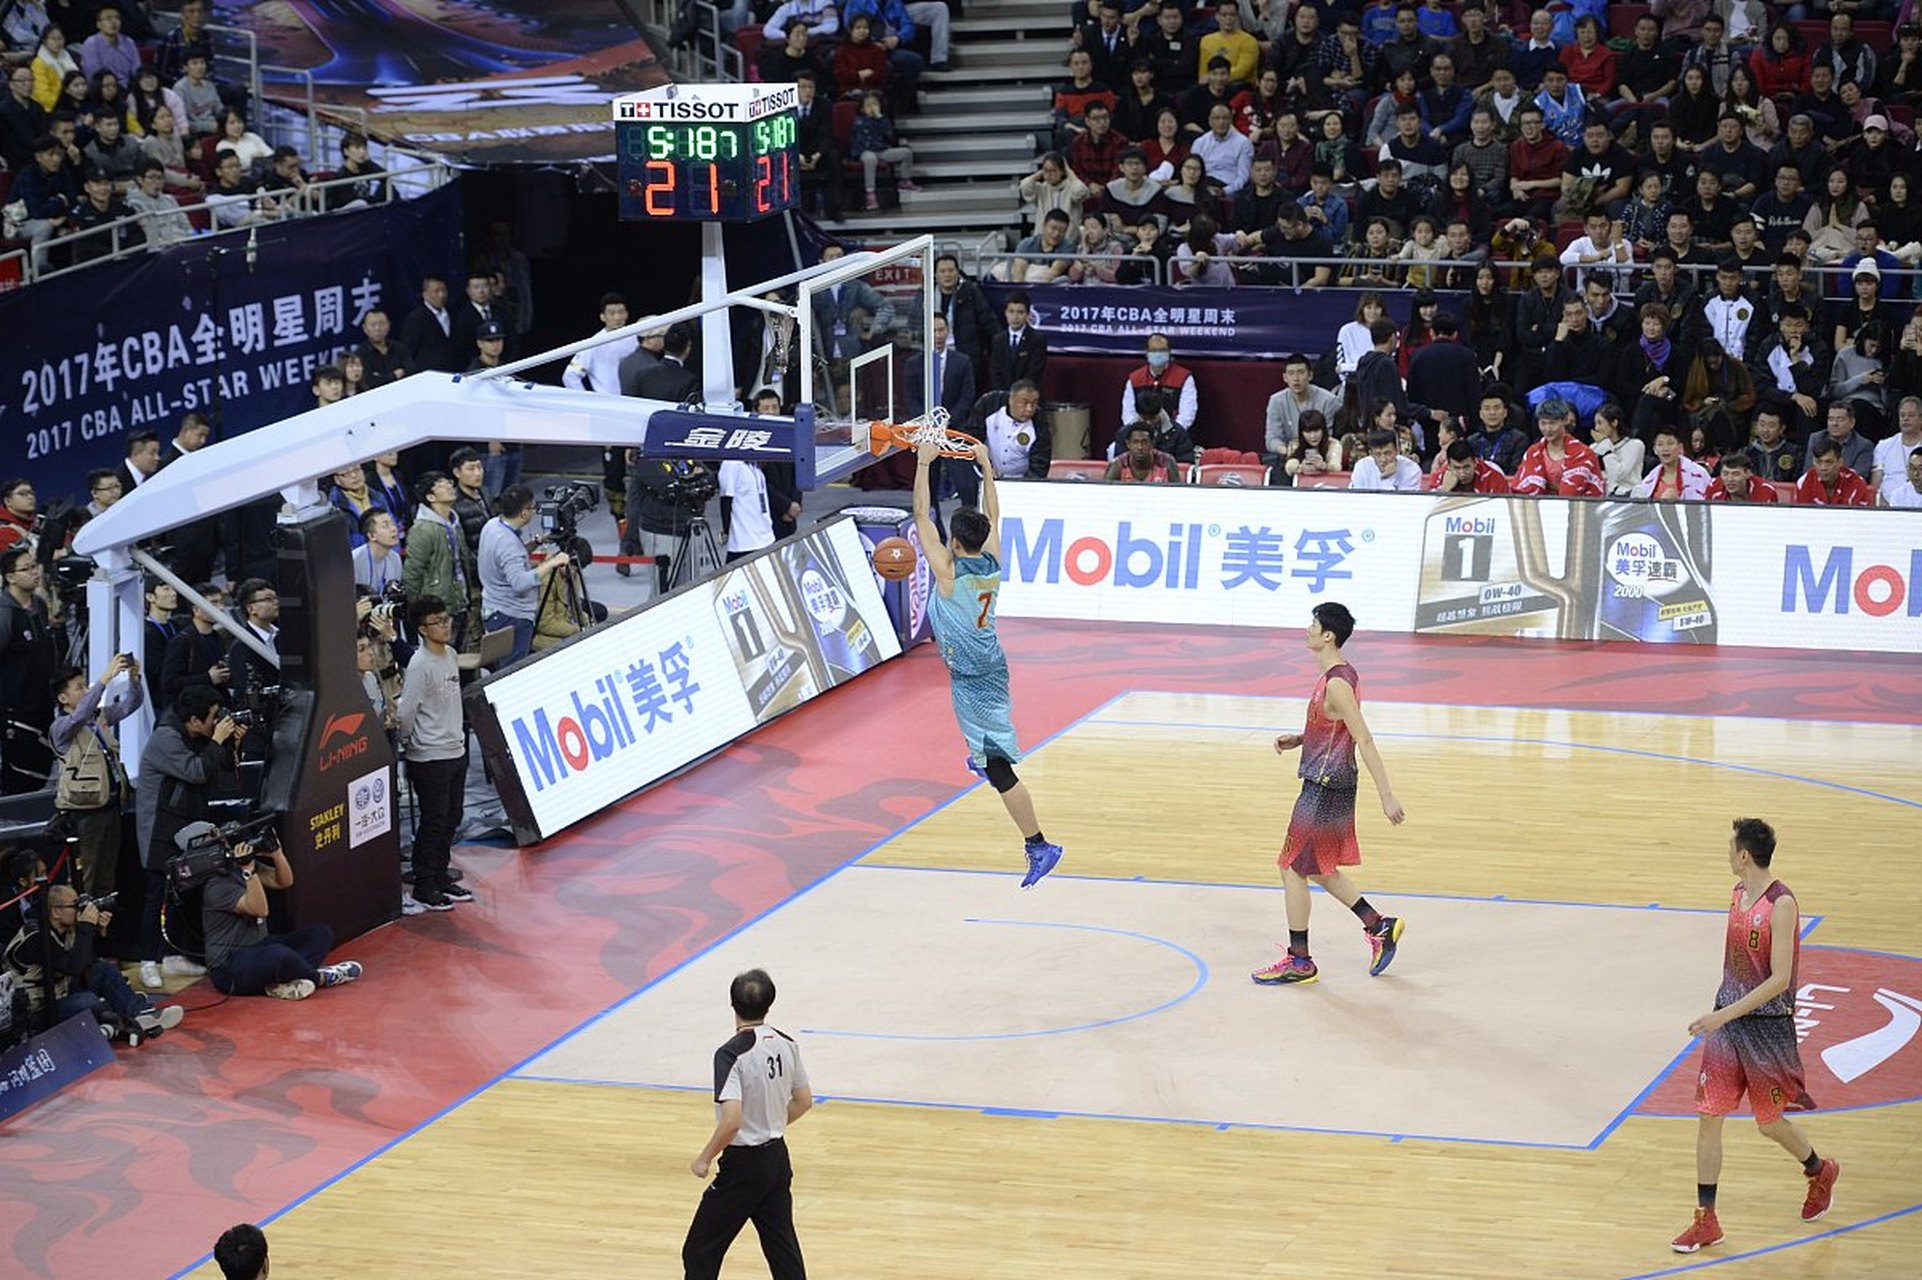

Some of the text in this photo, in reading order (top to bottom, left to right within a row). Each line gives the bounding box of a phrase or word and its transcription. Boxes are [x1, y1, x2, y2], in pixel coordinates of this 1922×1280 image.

[654, 102, 739, 119] TISSOT
[761, 88, 796, 112] TISSOT
[875, 268, 910, 281] EXIT
[1060, 305, 1236, 325] 2017年CBA全明星周末
[1060, 323, 1236, 337] 2017 CBA ALL-STAR WEEKEND
[26, 420, 72, 460] 2017
[81, 404, 123, 441] CBA
[131, 372, 250, 427] ALL-STAR
[1445, 517, 1495, 534] Mobil
[1000, 517, 1203, 589] Mobil
[1220, 525, 1356, 594] 美孚
[1458, 537, 1475, 579] 1
[1616, 542, 1657, 558] Mobil
[1614, 584, 1642, 598] 2000
[976, 591, 993, 629] 7
[511, 641, 701, 792] Mobil 美孚
[320, 736, 369, 771] LI-NING
[766, 1053, 783, 1080] 31
